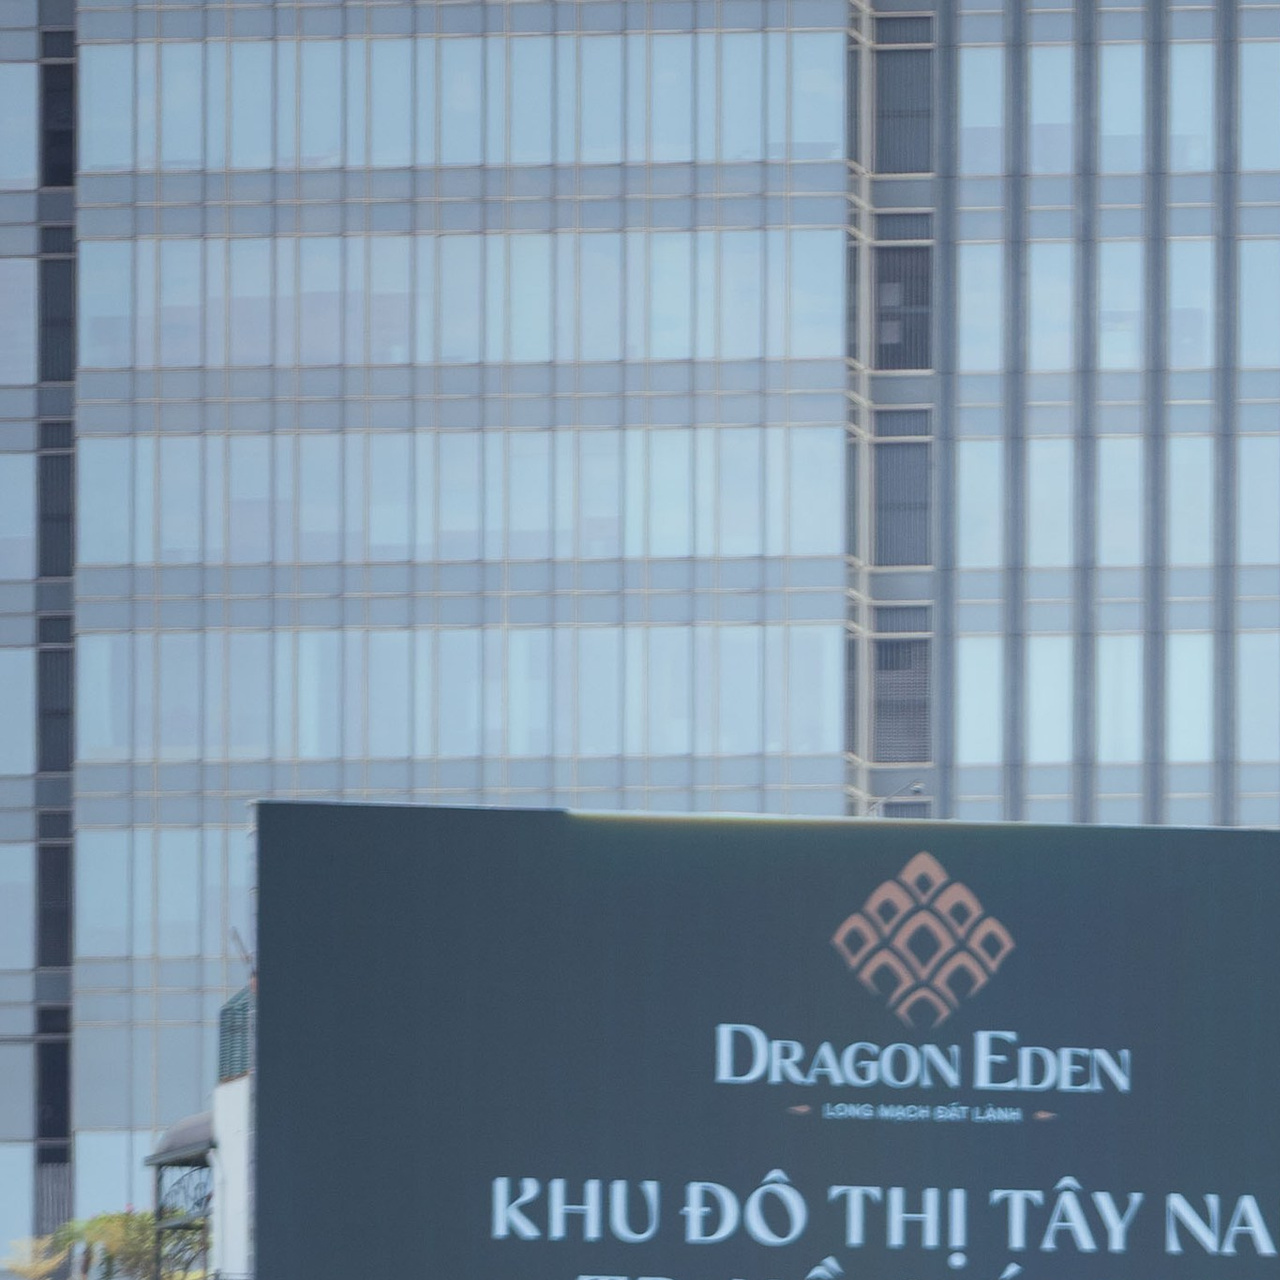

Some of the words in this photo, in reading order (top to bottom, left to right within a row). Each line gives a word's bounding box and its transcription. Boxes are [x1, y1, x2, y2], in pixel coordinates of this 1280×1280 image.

[715, 1023, 961, 1089] DRAGON
[972, 1030, 1131, 1093] EDEN
[823, 1103, 874, 1119] LONG
[491, 1176, 660, 1243] KHU
[679, 1168, 808, 1247] ĐÔ
[827, 1184, 968, 1269] THỊ
[989, 1175, 1144, 1254] TÂY
